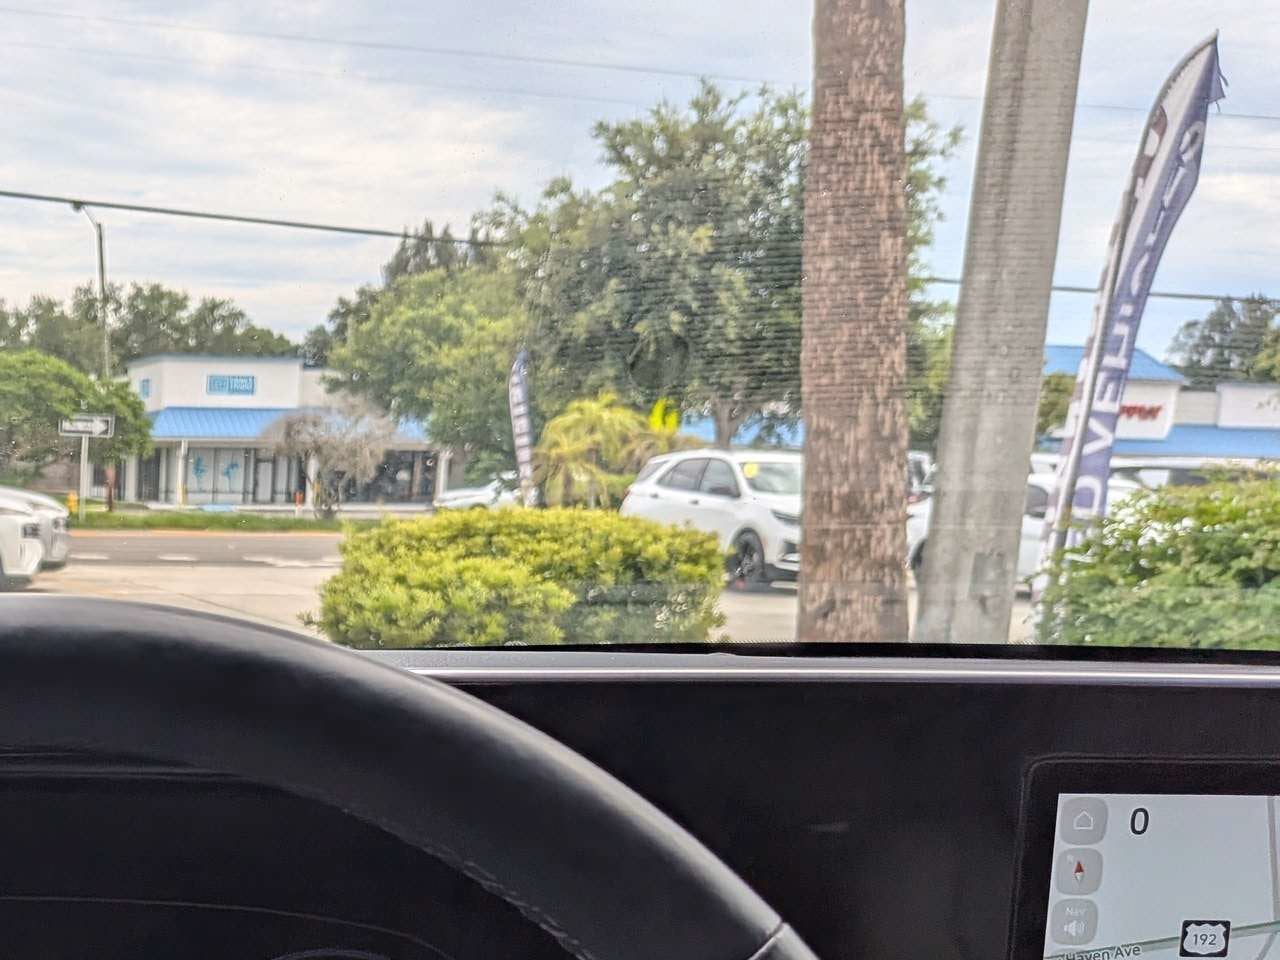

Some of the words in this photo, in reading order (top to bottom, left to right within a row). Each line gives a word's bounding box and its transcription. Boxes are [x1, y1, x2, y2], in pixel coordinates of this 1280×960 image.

[1129, 807, 1150, 836] 0
[1192, 933, 1218, 946] 192
[1114, 945, 1141, 960] Ave
